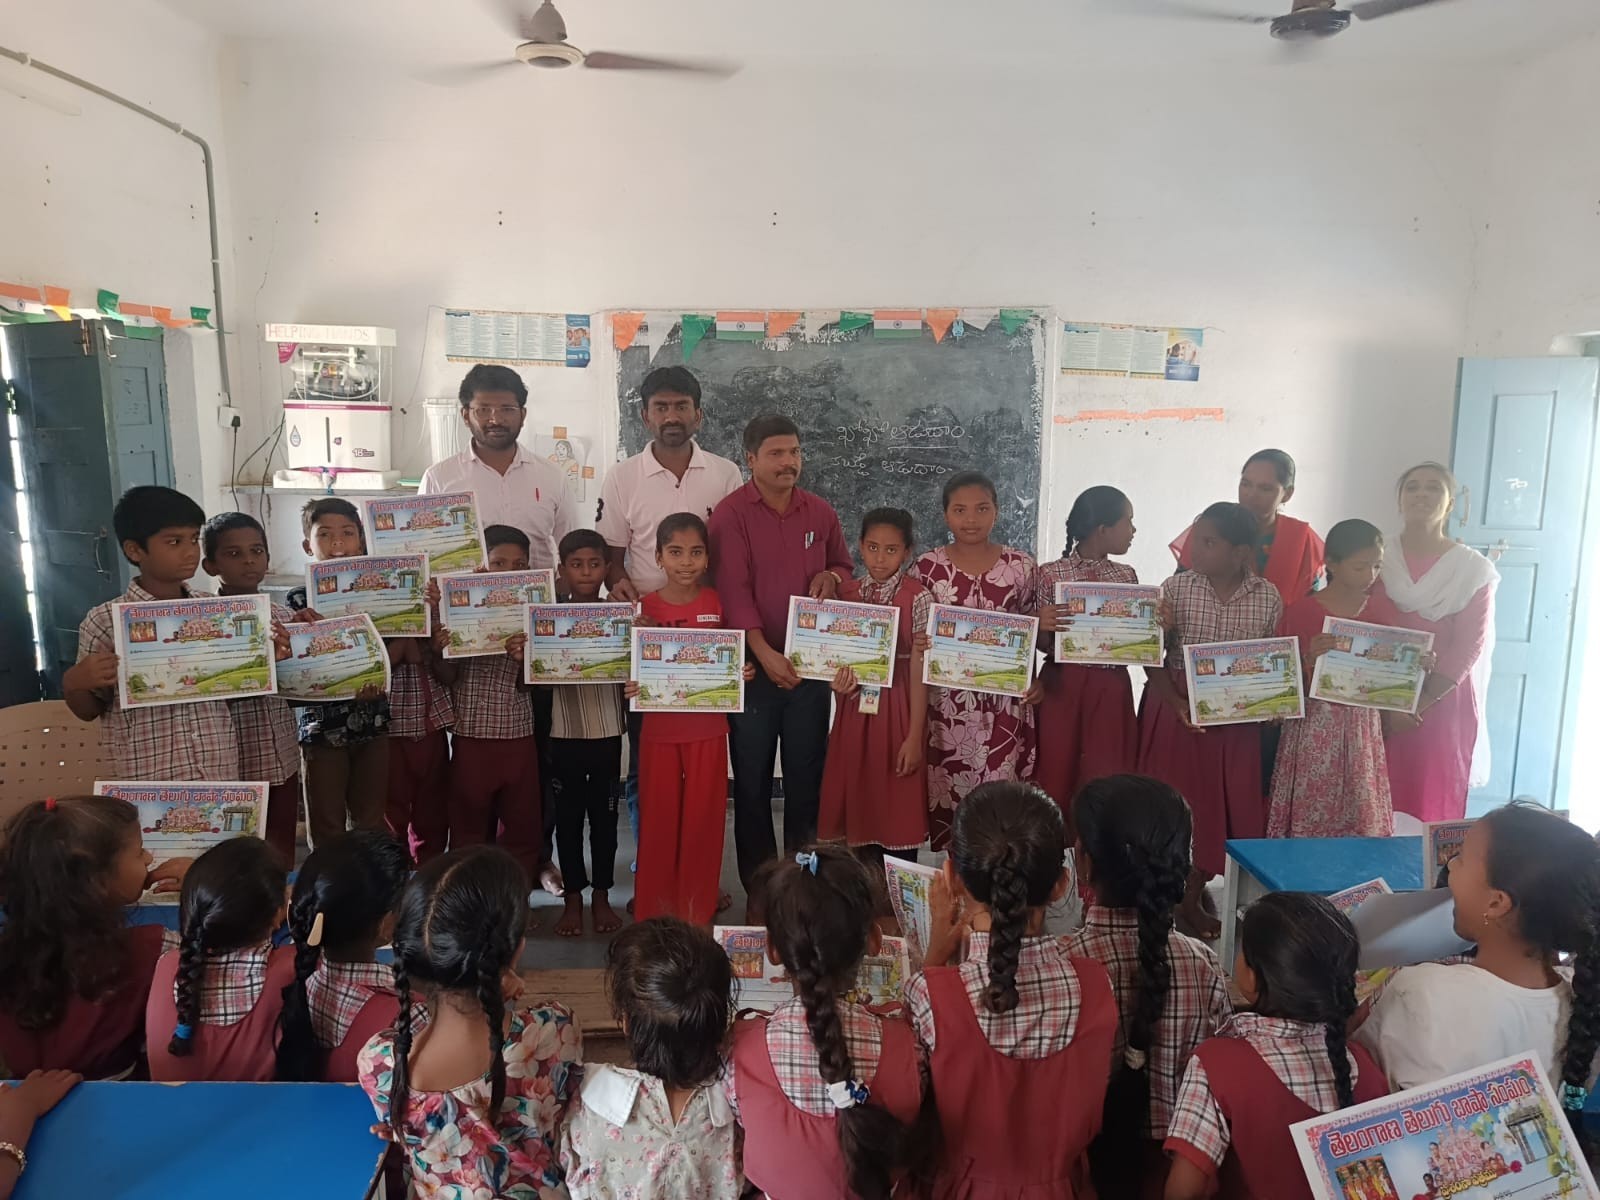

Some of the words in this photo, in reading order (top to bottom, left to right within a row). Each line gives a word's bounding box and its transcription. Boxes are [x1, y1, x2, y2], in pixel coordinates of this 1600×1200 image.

[111, 789, 157, 802] తెలంగాణ
[159, 788, 191, 803] తెలుగు
[193, 790, 219, 802] భాషా
[221, 789, 255, 801] సంఘం
[1327, 1119, 1402, 1158] తెలంగాణ
[1400, 1100, 1453, 1135] తెలుగు
[1451, 1088, 1489, 1120] భాషా
[1487, 1076, 1531, 1107] సంఘం
